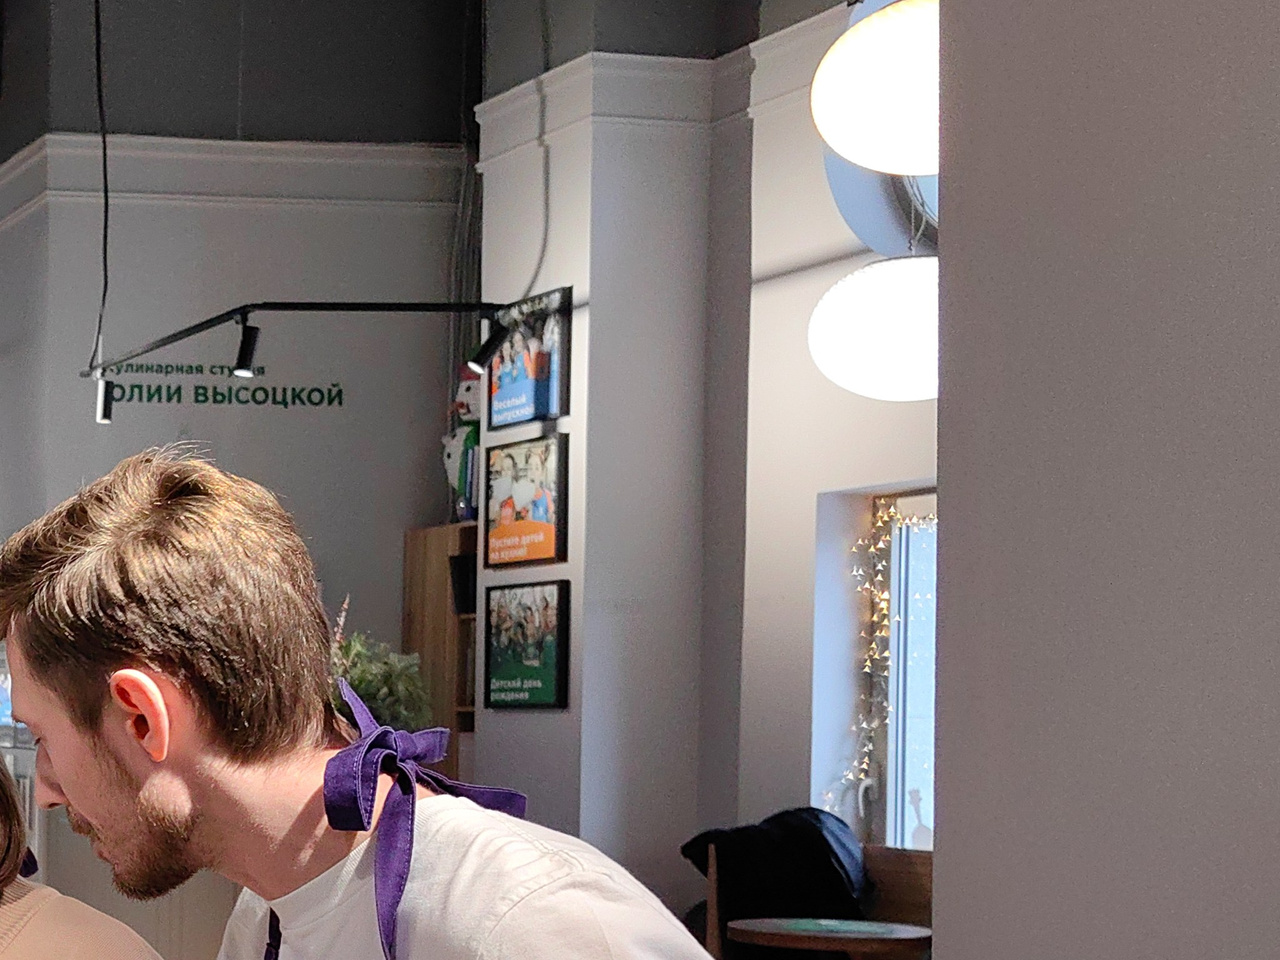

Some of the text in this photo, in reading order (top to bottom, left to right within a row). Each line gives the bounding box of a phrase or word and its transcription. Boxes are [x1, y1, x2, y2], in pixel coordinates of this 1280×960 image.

[108, 363, 266, 378] улинарная стуя
[194, 383, 344, 409] ВЫСОЦКОЙ
